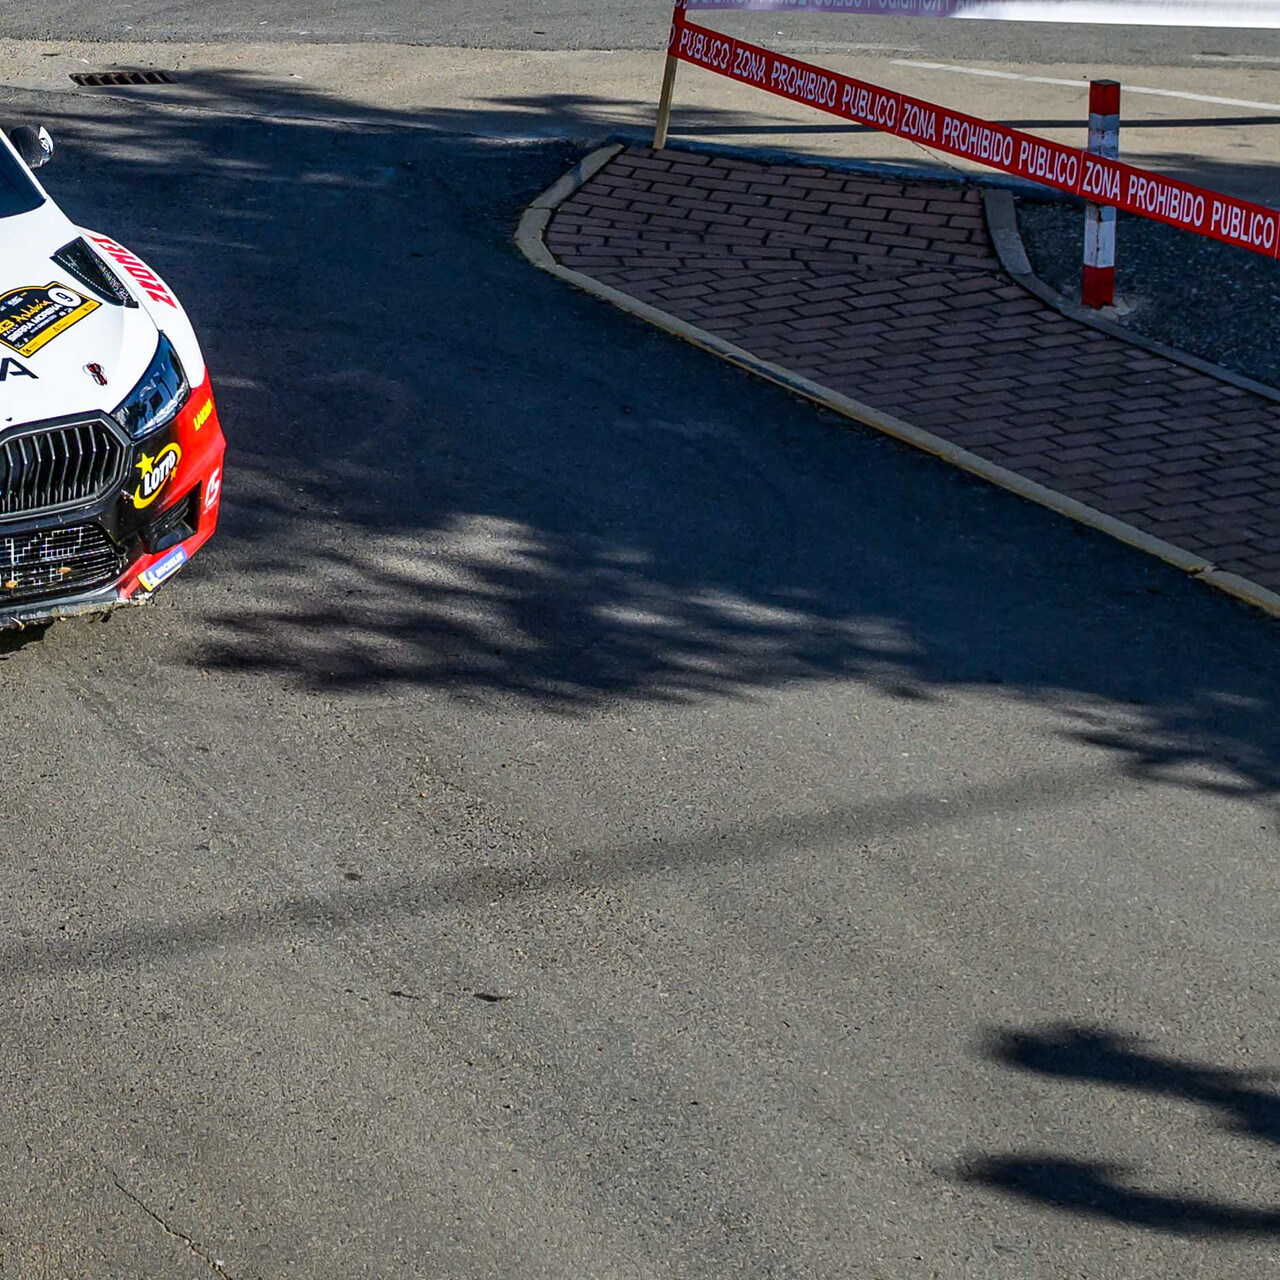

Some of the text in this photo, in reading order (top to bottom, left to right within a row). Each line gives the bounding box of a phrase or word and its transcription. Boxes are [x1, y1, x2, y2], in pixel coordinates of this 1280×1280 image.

[679, 28, 1276, 249] PUBLICO ZONA PROHIBIDO PUBLICO ZONA PROHIBIDO PUBLICO ZONA PROHIBIDO PUBLICO
[55, 291, 74, 302] 9
[193, 398, 213, 431] LAKMA
[143, 450, 178, 496] LOTTO
[156, 551, 184, 579] MICHELIN
